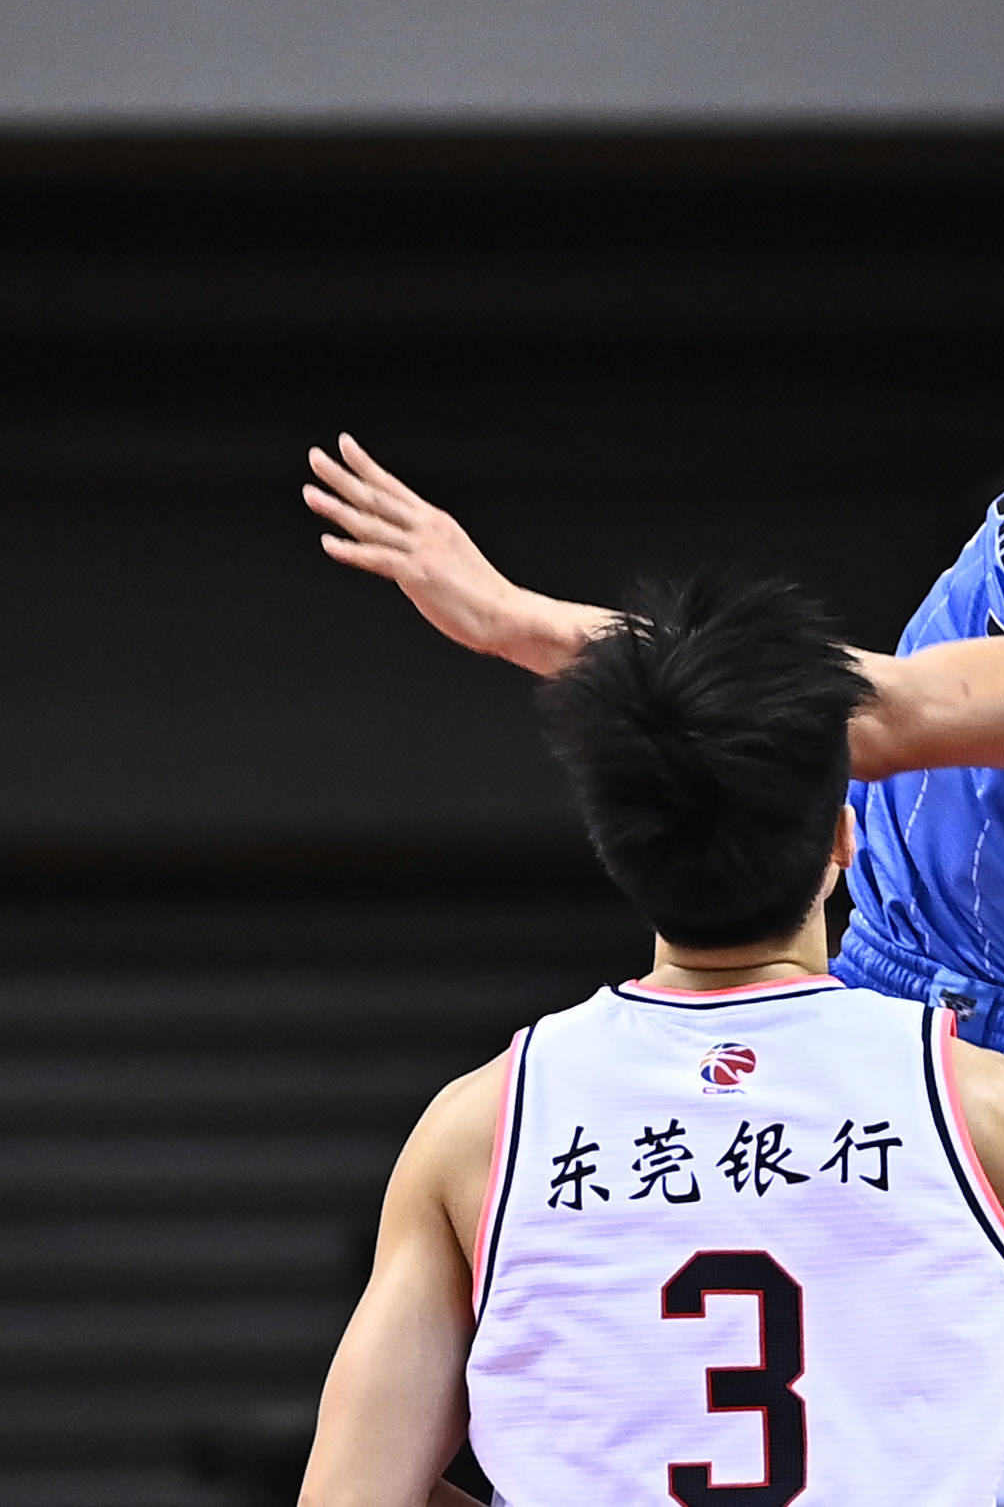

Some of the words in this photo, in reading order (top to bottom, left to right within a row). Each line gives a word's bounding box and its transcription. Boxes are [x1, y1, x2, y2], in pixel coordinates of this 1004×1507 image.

[548, 1119, 902, 1211] 东莞银行
[661, 1250, 807, 1506] 3
